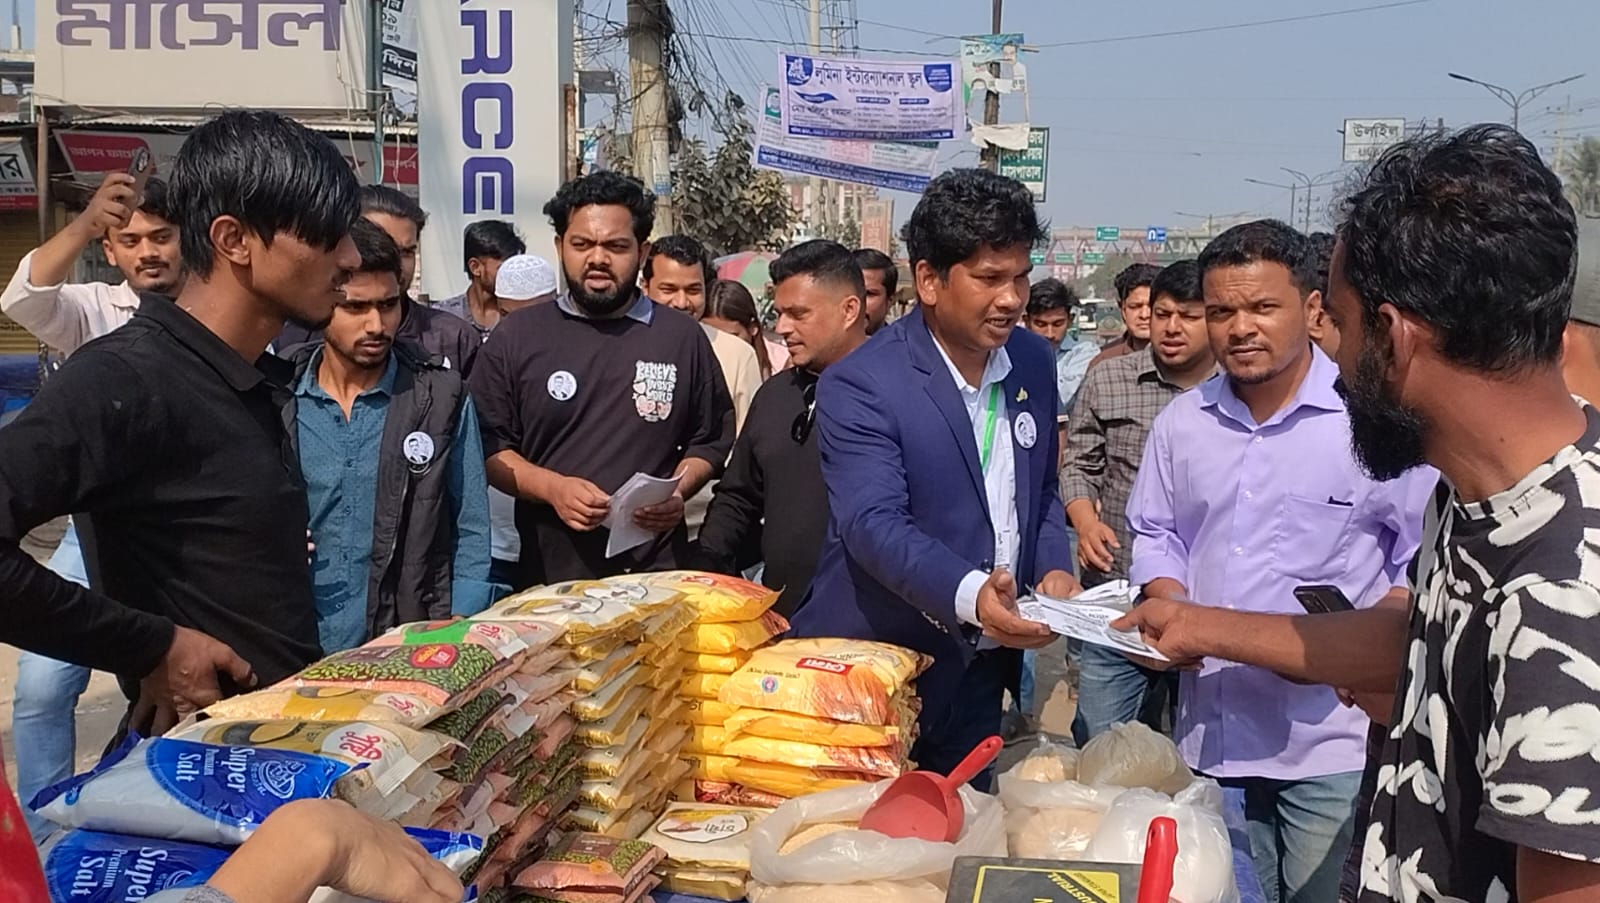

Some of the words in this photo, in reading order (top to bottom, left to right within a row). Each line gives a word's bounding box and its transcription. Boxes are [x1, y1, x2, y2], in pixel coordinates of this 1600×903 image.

[815, 63, 842, 86] লুমিনা
[461, 0, 515, 228] RCE
[634, 360, 677, 381] BELIEVE
[176, 753, 202, 782] Salt
[221, 747, 256, 793] Super
[70, 855, 106, 897] Salt
[101, 848, 128, 889] Premium
